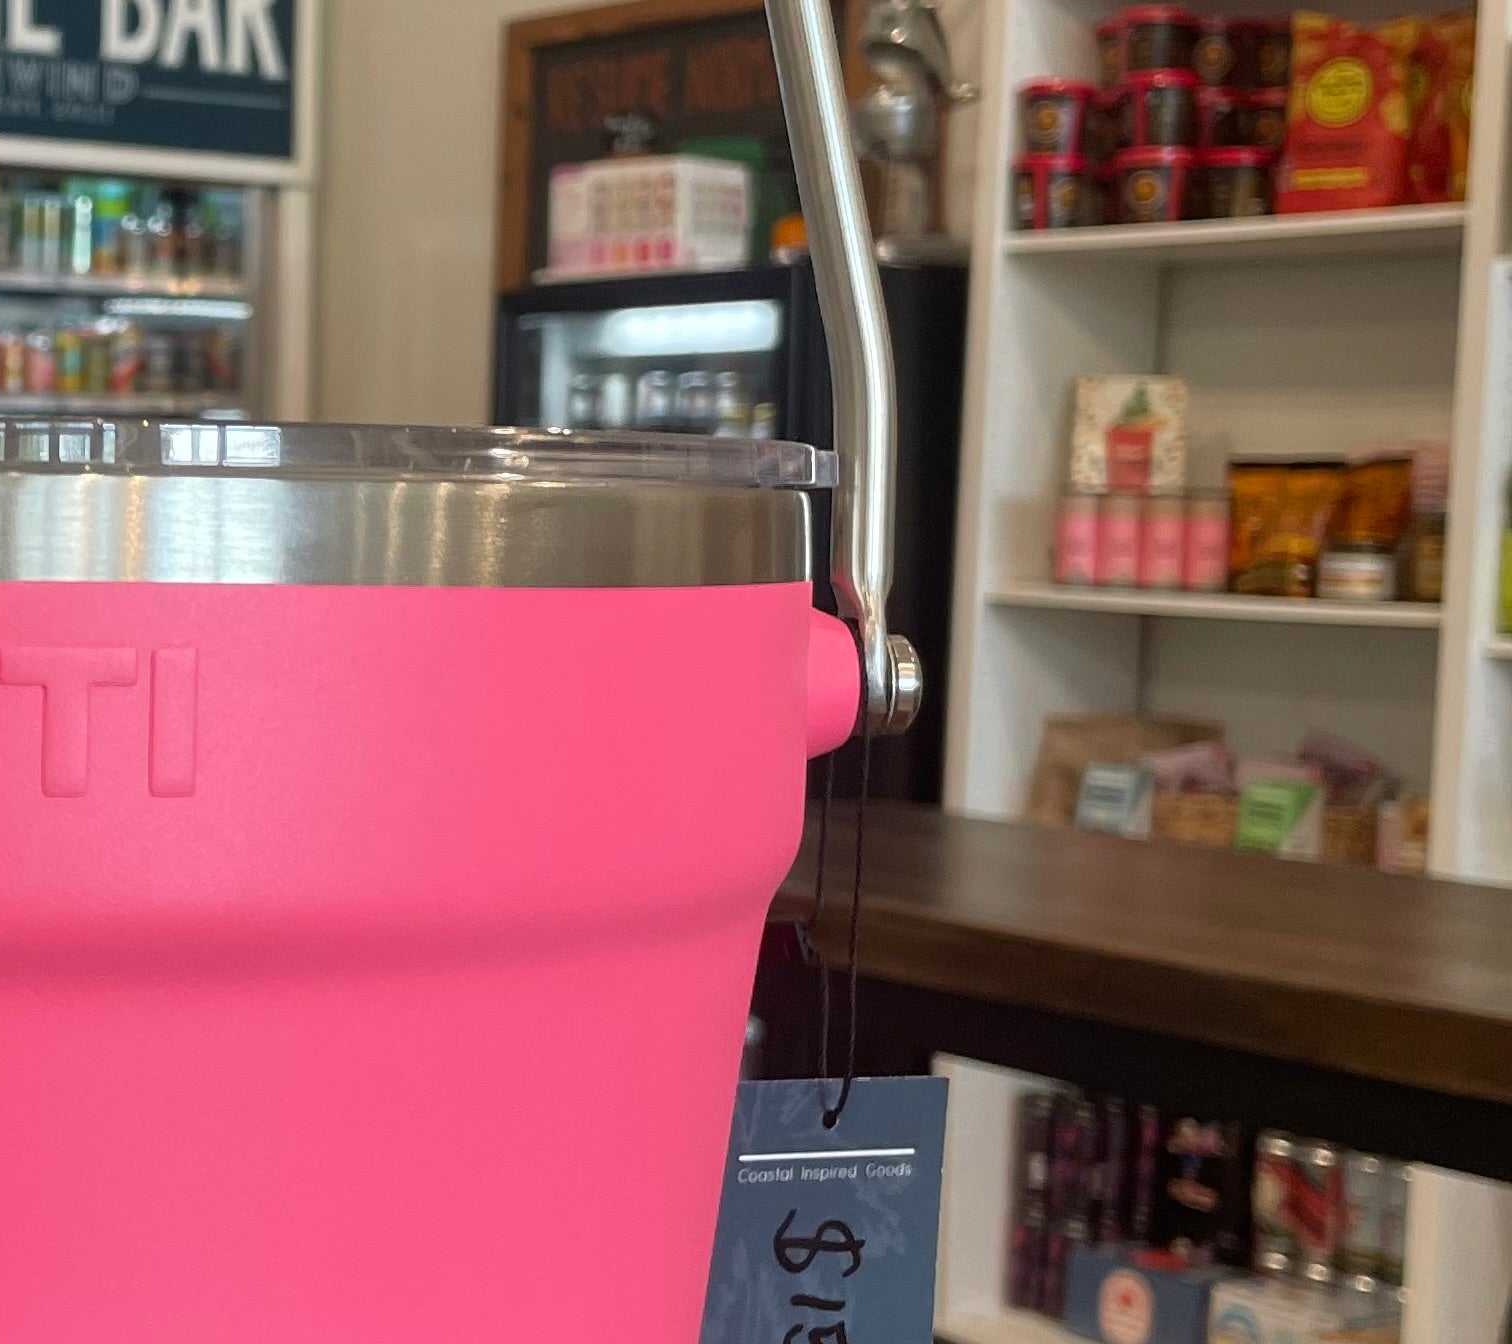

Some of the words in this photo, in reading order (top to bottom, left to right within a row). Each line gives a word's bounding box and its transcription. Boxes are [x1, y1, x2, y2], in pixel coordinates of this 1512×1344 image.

[737, 1166, 794, 1184] Coastal
[800, 1164, 858, 1183] Inspired
[865, 1161, 913, 1179] Goods
